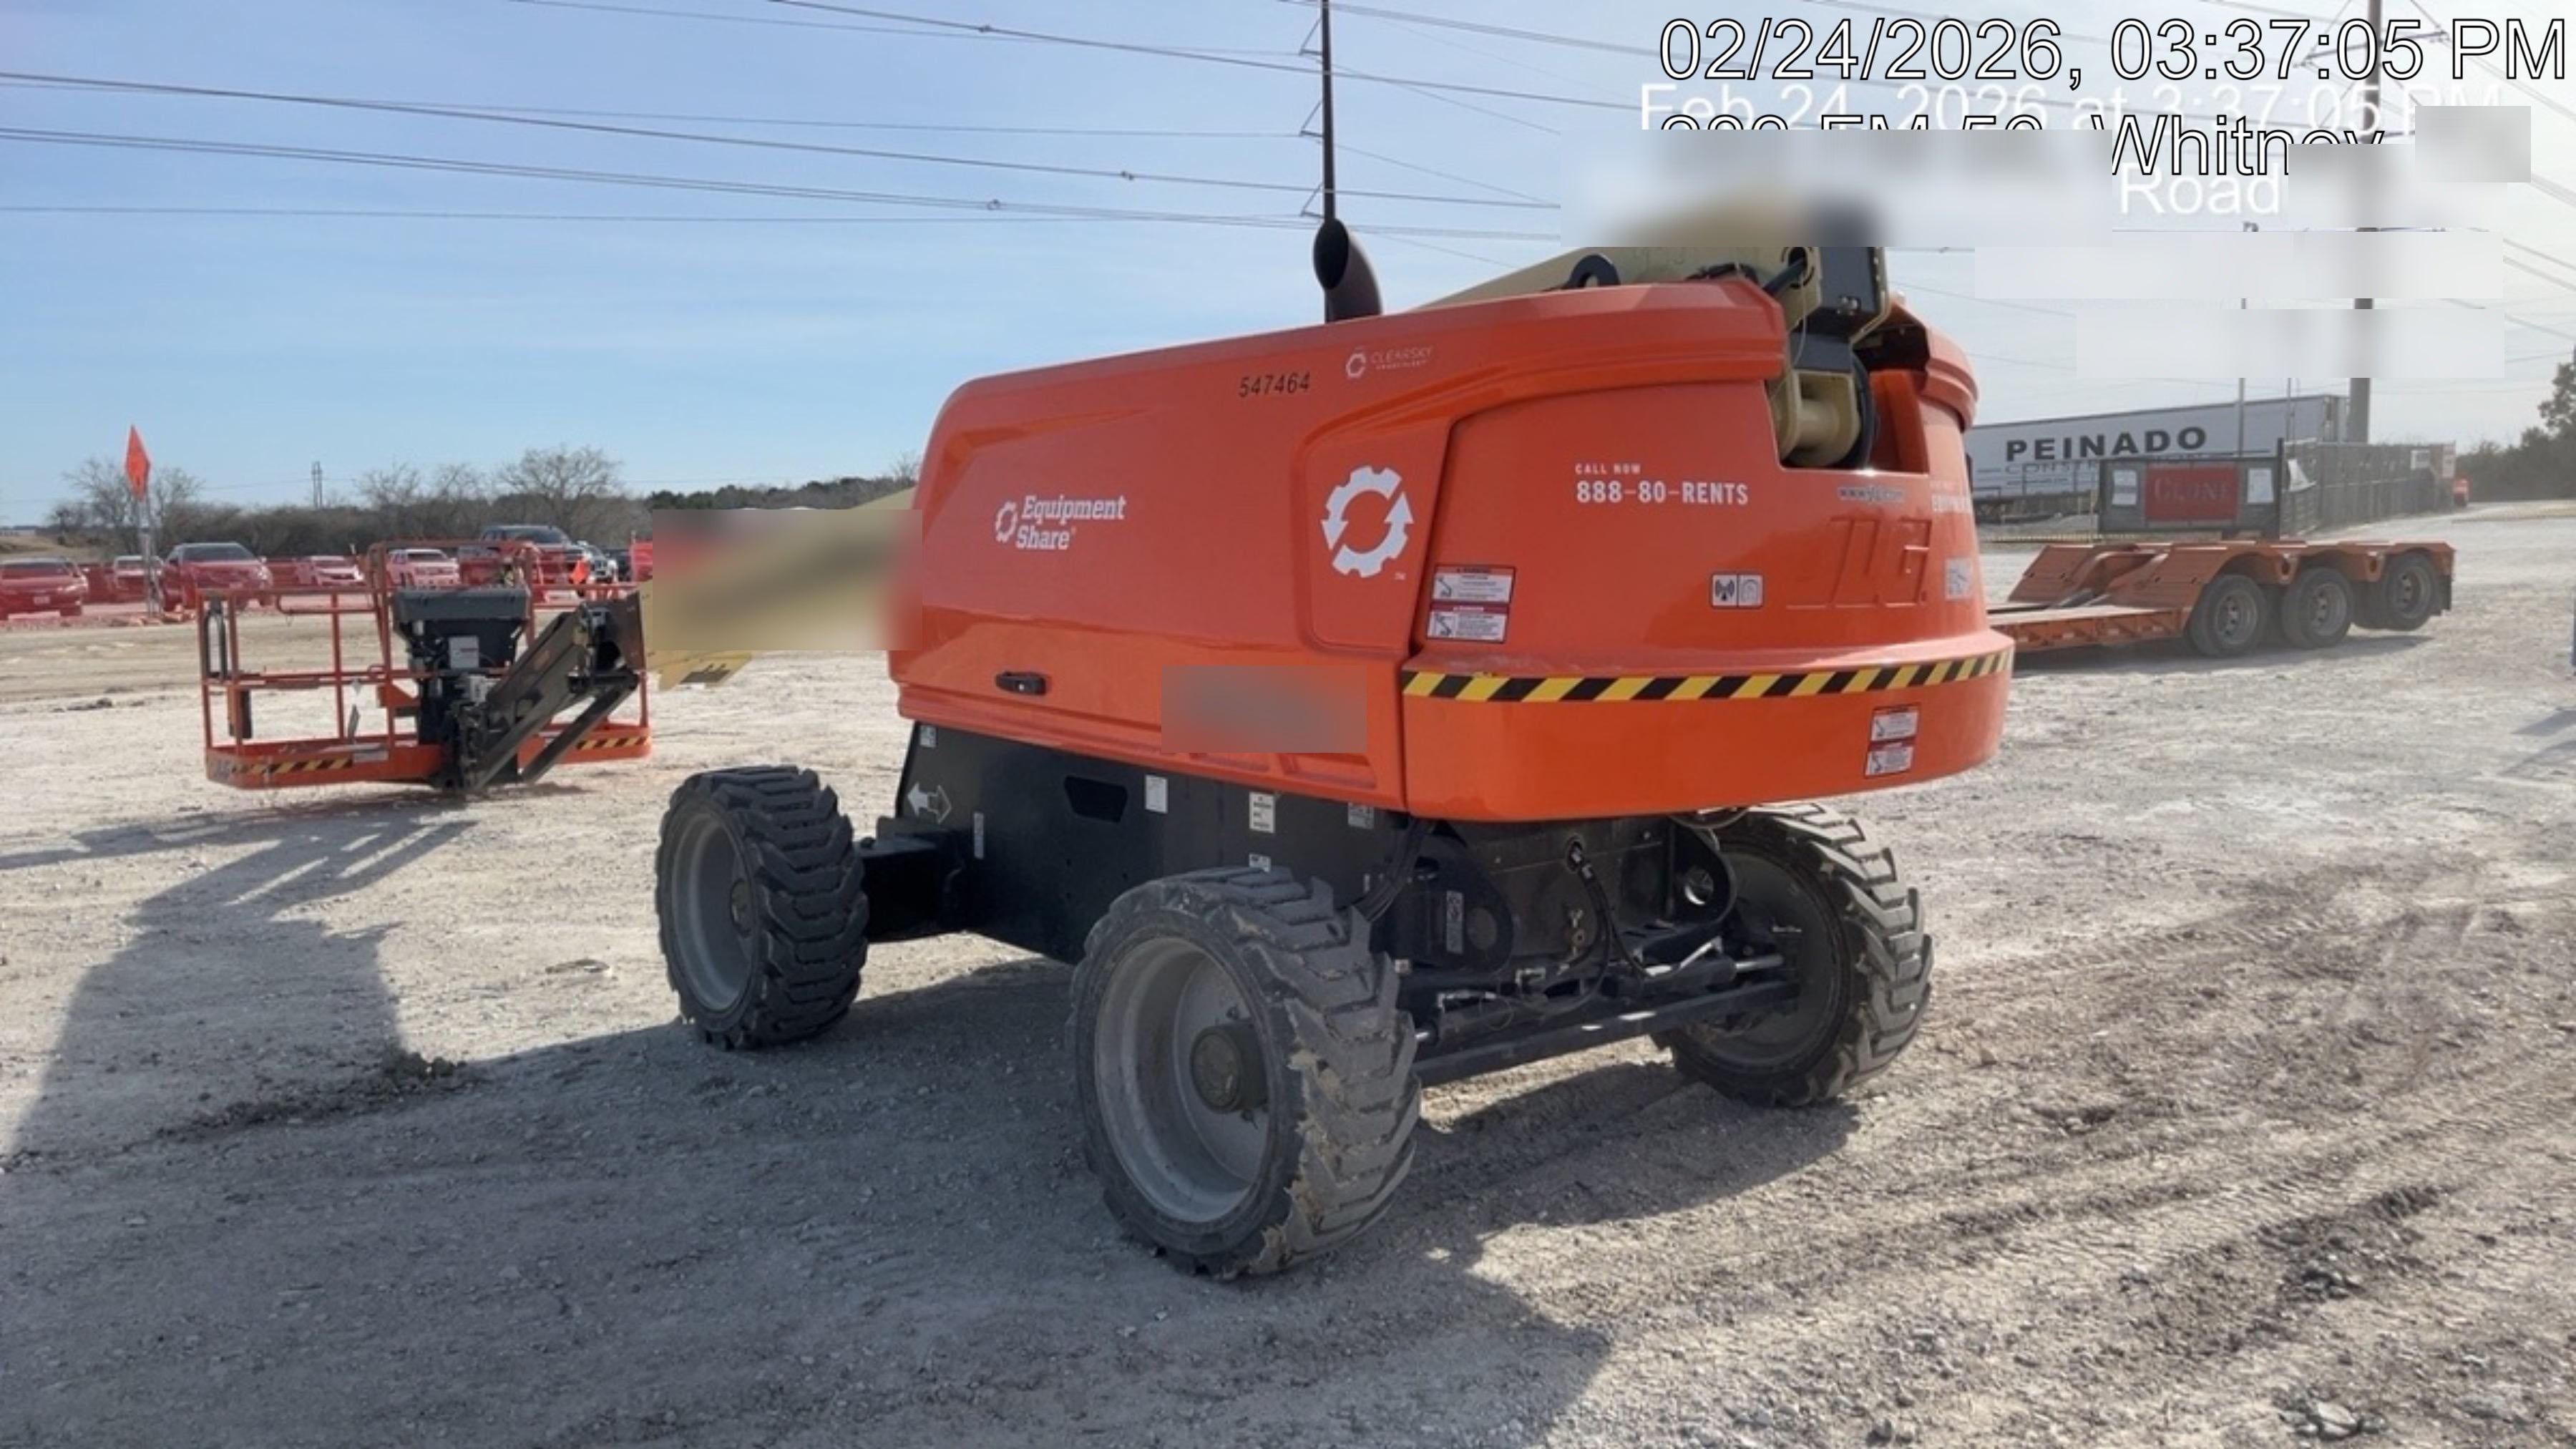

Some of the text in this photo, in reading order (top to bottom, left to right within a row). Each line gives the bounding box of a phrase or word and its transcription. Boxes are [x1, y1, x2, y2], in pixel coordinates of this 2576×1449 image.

[1238, 371, 1311, 398] 547464
[2006, 426, 2207, 462] PEINADO
[1575, 464, 1641, 475] CALL NOW
[1576, 480, 1748, 505] 888-80-RENTS
[1020, 494, 1127, 525] Equipment
[1015, 525, 1071, 550] Share
